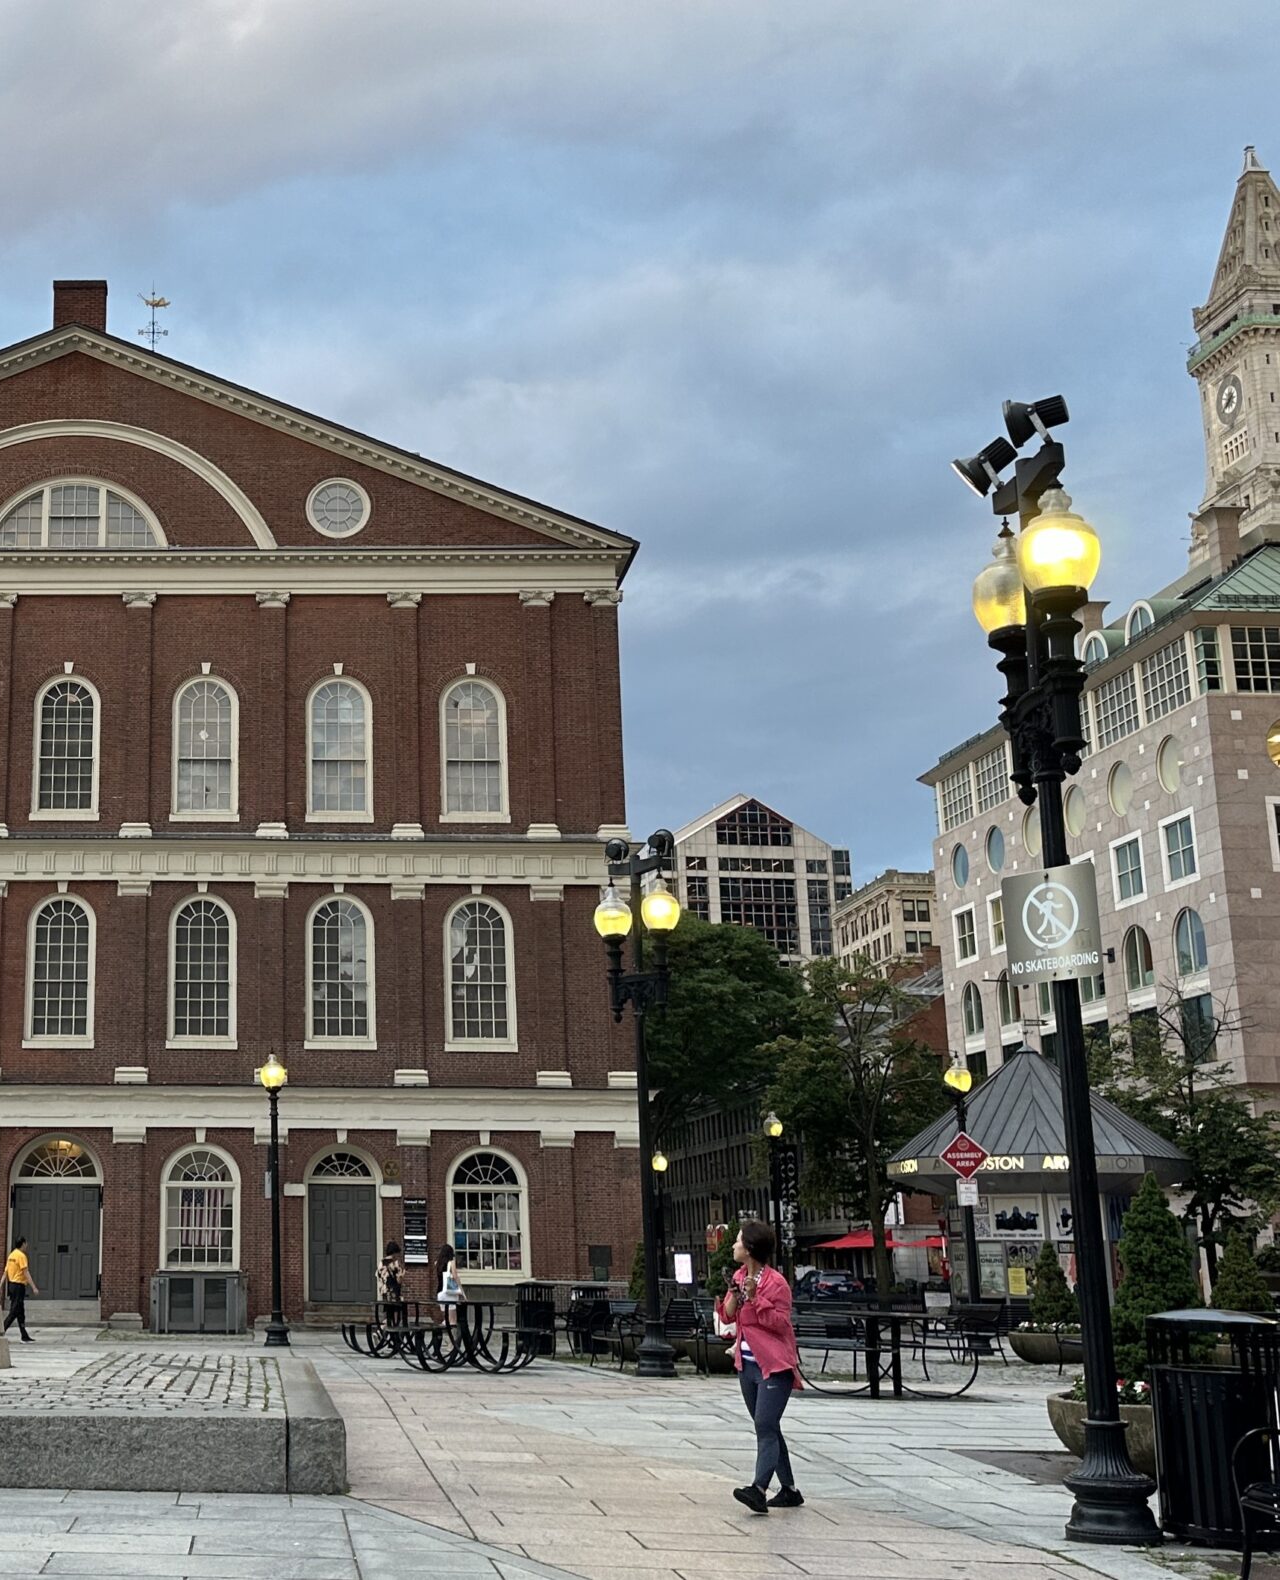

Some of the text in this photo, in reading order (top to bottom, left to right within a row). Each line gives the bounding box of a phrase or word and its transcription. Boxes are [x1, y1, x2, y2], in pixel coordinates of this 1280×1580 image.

[1011, 951, 1099, 975] NO SKATEBOARDING
[946, 1151, 983, 1159] ASSEMBLY
